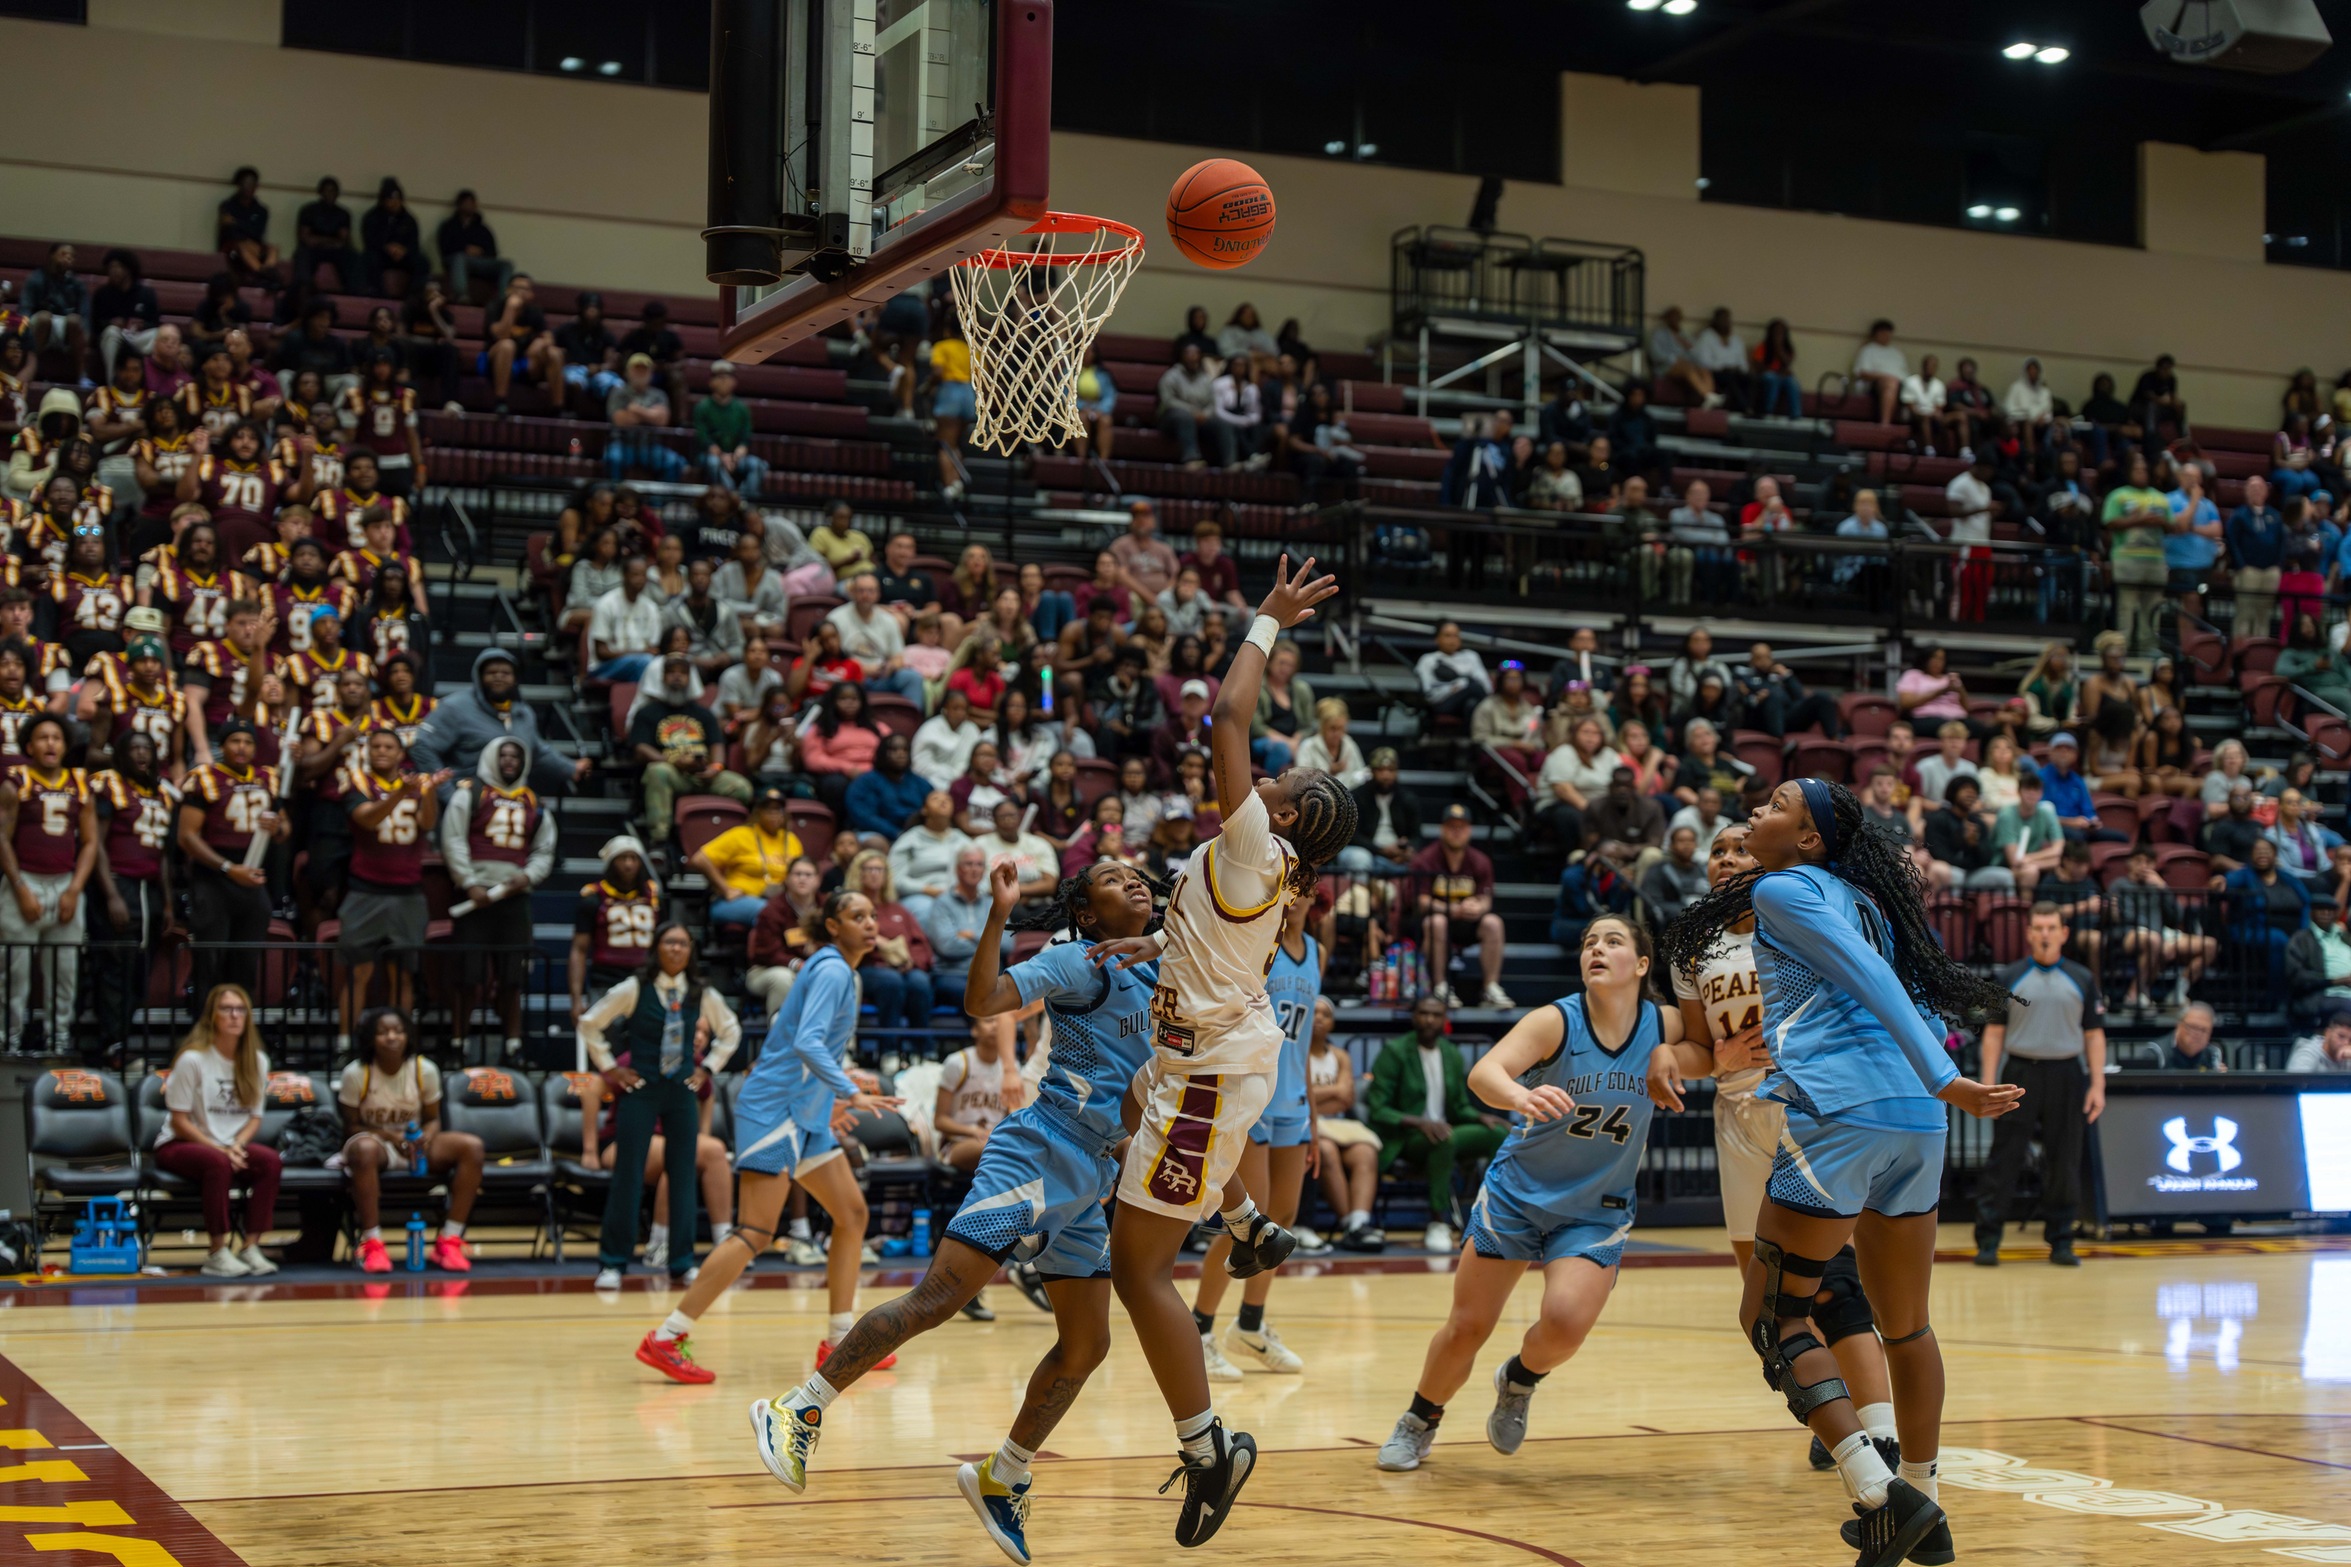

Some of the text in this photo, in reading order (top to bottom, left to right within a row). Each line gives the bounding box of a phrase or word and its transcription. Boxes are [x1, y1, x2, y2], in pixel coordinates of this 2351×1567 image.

[1218, 202, 1273, 224] LEGACY
[219, 474, 265, 513] 70
[287, 607, 313, 651] 9
[41, 796, 70, 837] 5
[1276, 1000, 1309, 1043] 20
[1719, 1005, 1763, 1039] 14
[1566, 1071, 1650, 1100] GULF COAS
[1566, 1103, 1633, 1146] 24
